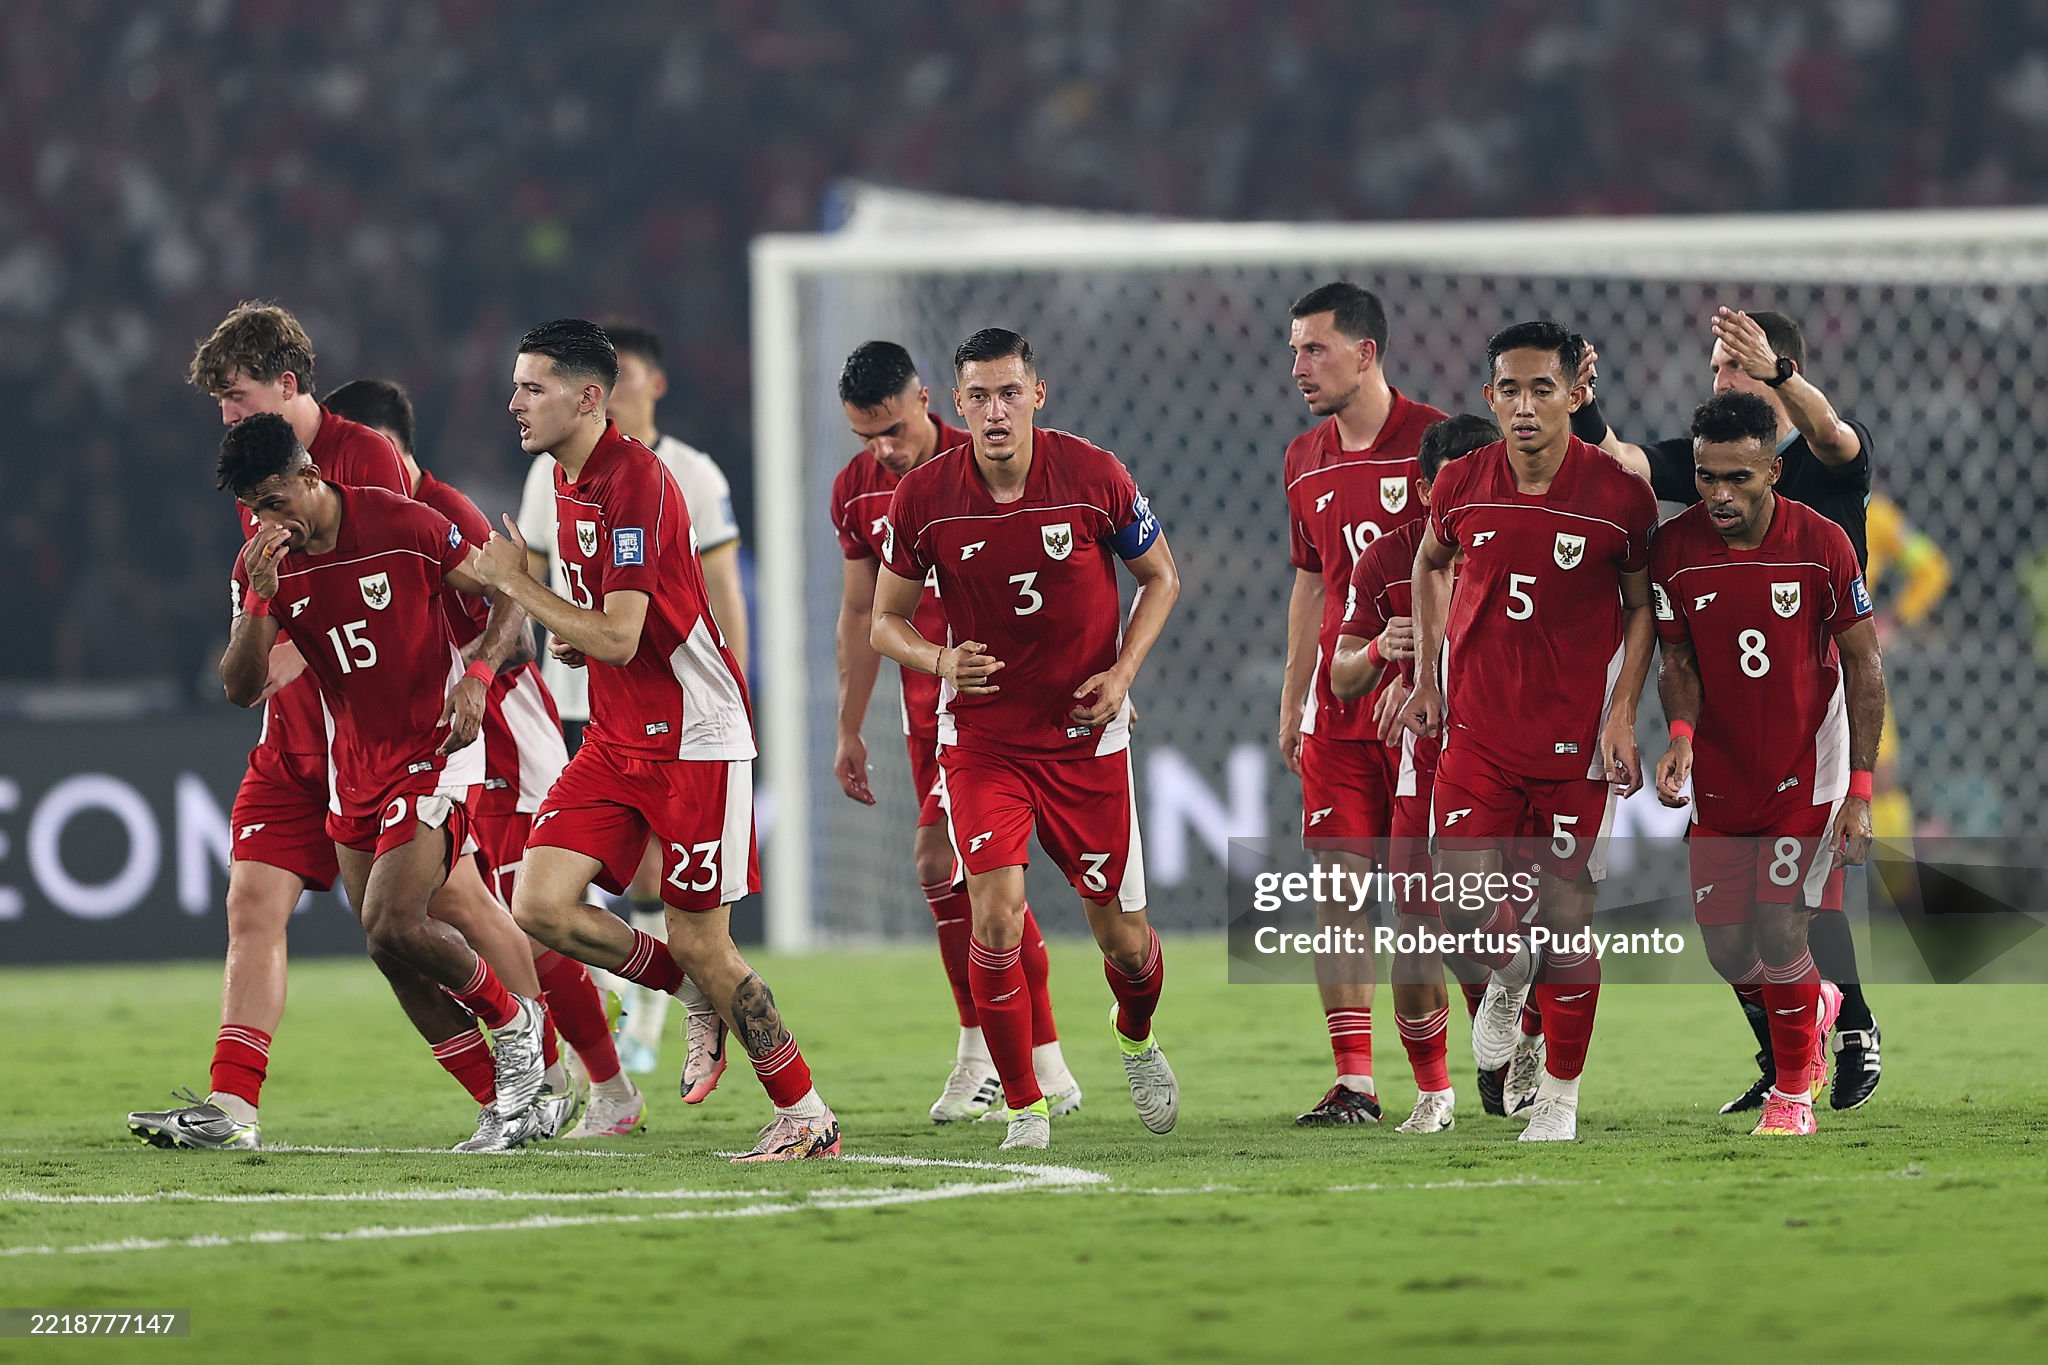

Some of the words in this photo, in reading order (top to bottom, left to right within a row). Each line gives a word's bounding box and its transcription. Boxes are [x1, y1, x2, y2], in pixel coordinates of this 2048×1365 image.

[1138, 507, 1157, 546] AF
[1008, 571, 1043, 616] 3
[1506, 573, 1538, 620] 5
[326, 619, 377, 674] 15
[1738, 628, 1770, 678] 8
[1550, 813, 1579, 859] 5
[666, 839, 721, 892] 23
[1080, 853, 1111, 892] 3
[1768, 836, 1801, 886] 8
